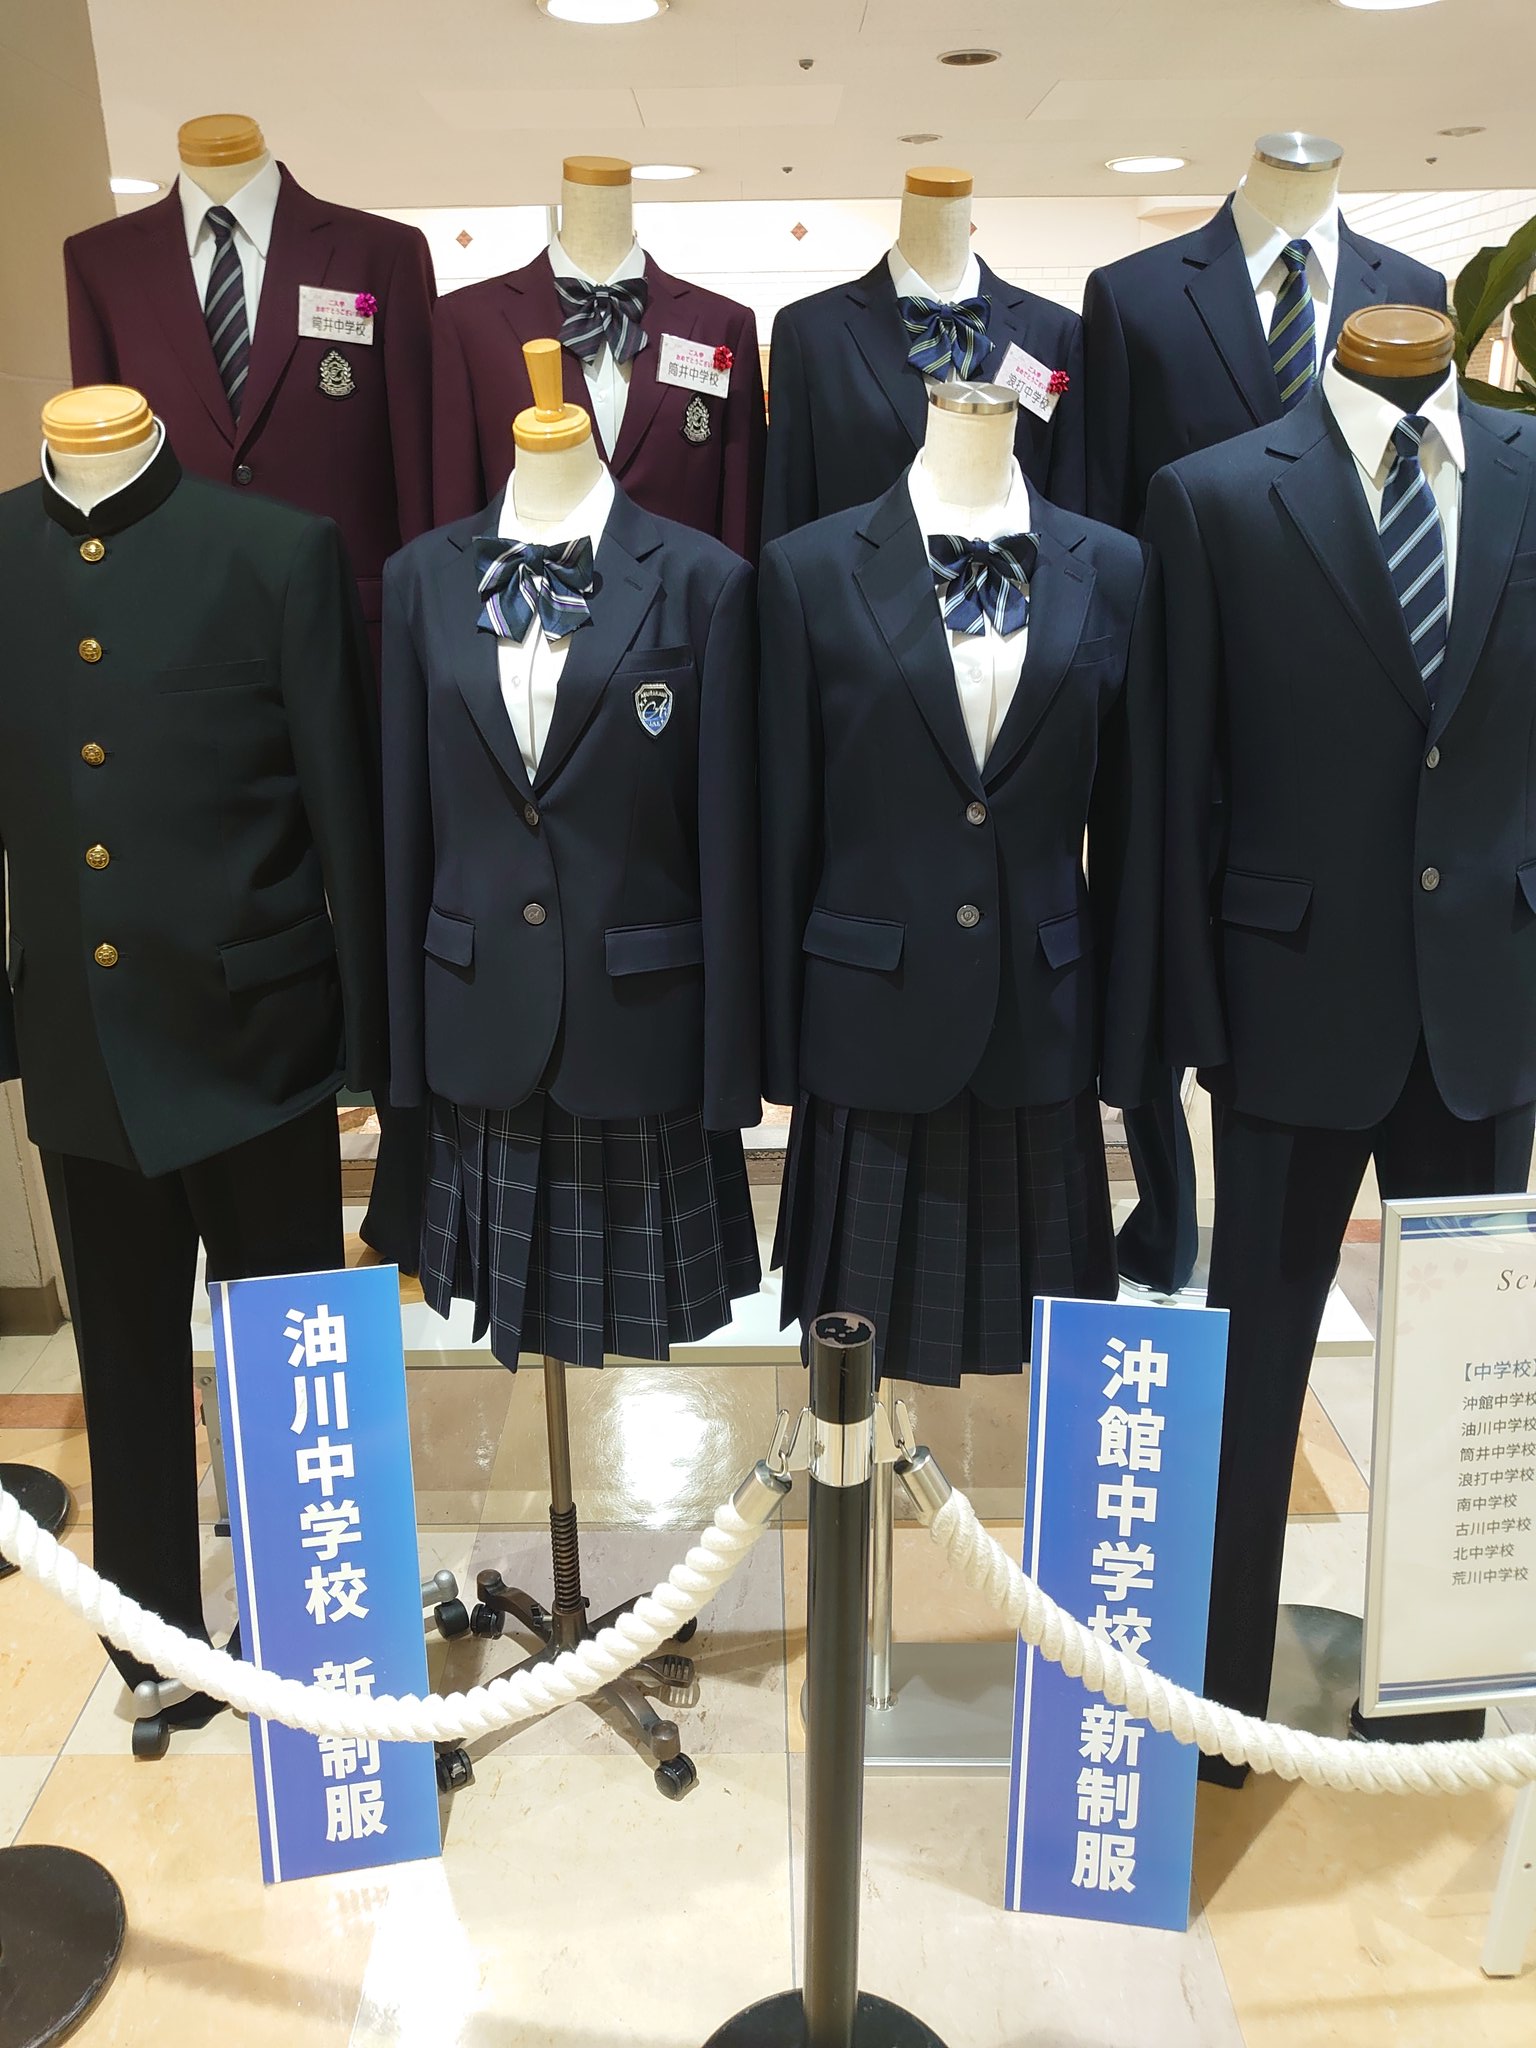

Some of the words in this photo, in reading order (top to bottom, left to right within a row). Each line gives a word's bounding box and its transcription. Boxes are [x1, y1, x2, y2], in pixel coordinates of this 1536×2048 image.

[312, 315, 366, 337] 筒井中学校
[668, 361, 719, 387] 筒井中学校
[1006, 373, 1050, 411] 浪打中学校
[1463, 1391, 1536, 1411] 沖館中学校
[1461, 1416, 1536, 1437] 油川中学校
[1460, 1442, 1536, 1462] 筒井中学校
[282, 1303, 370, 1626] 油川中学校
[1458, 1467, 1535, 1487] 浪打中学校
[1087, 1336, 1170, 1669] 沖館中学校
[1456, 1493, 1518, 1512] 南中学校
[1455, 1516, 1532, 1537] 古川中学校
[1453, 1542, 1515, 1561] 北中学校
[1451, 1566, 1529, 1586] 荒川中学校
[313, 1656, 388, 1842] 新制服
[1072, 1703, 1146, 1894] 新制服
